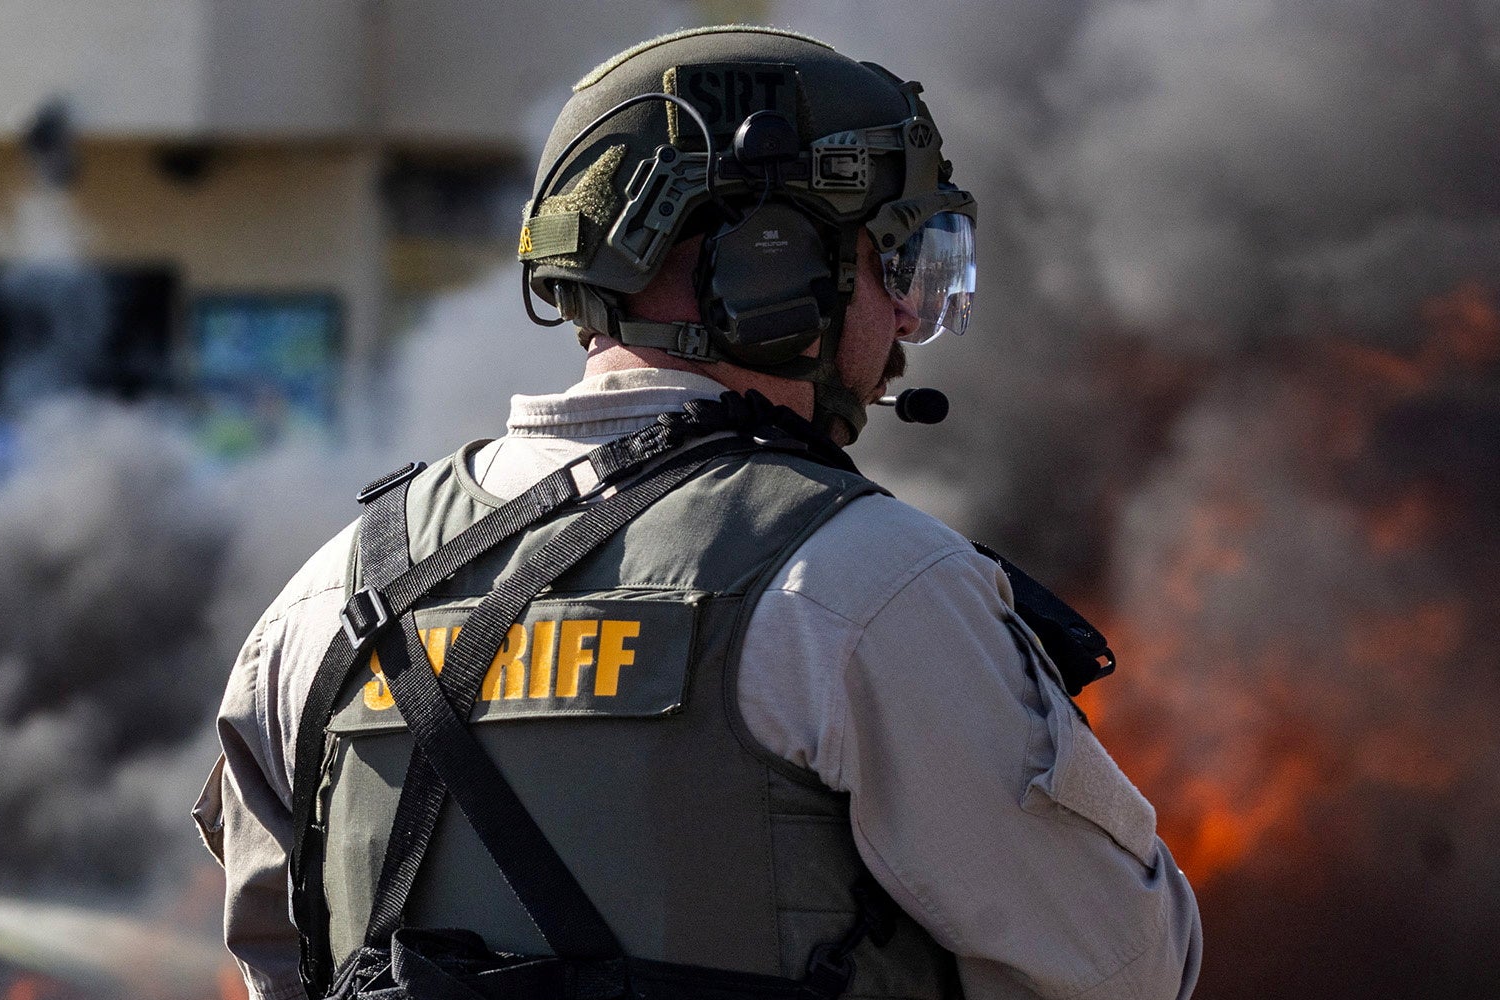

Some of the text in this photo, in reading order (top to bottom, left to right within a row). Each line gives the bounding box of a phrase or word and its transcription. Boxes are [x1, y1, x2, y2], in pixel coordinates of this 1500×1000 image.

[688, 70, 786, 125] SRT
[763, 230, 779, 240] 3M
[363, 619, 641, 711] SRIFF
